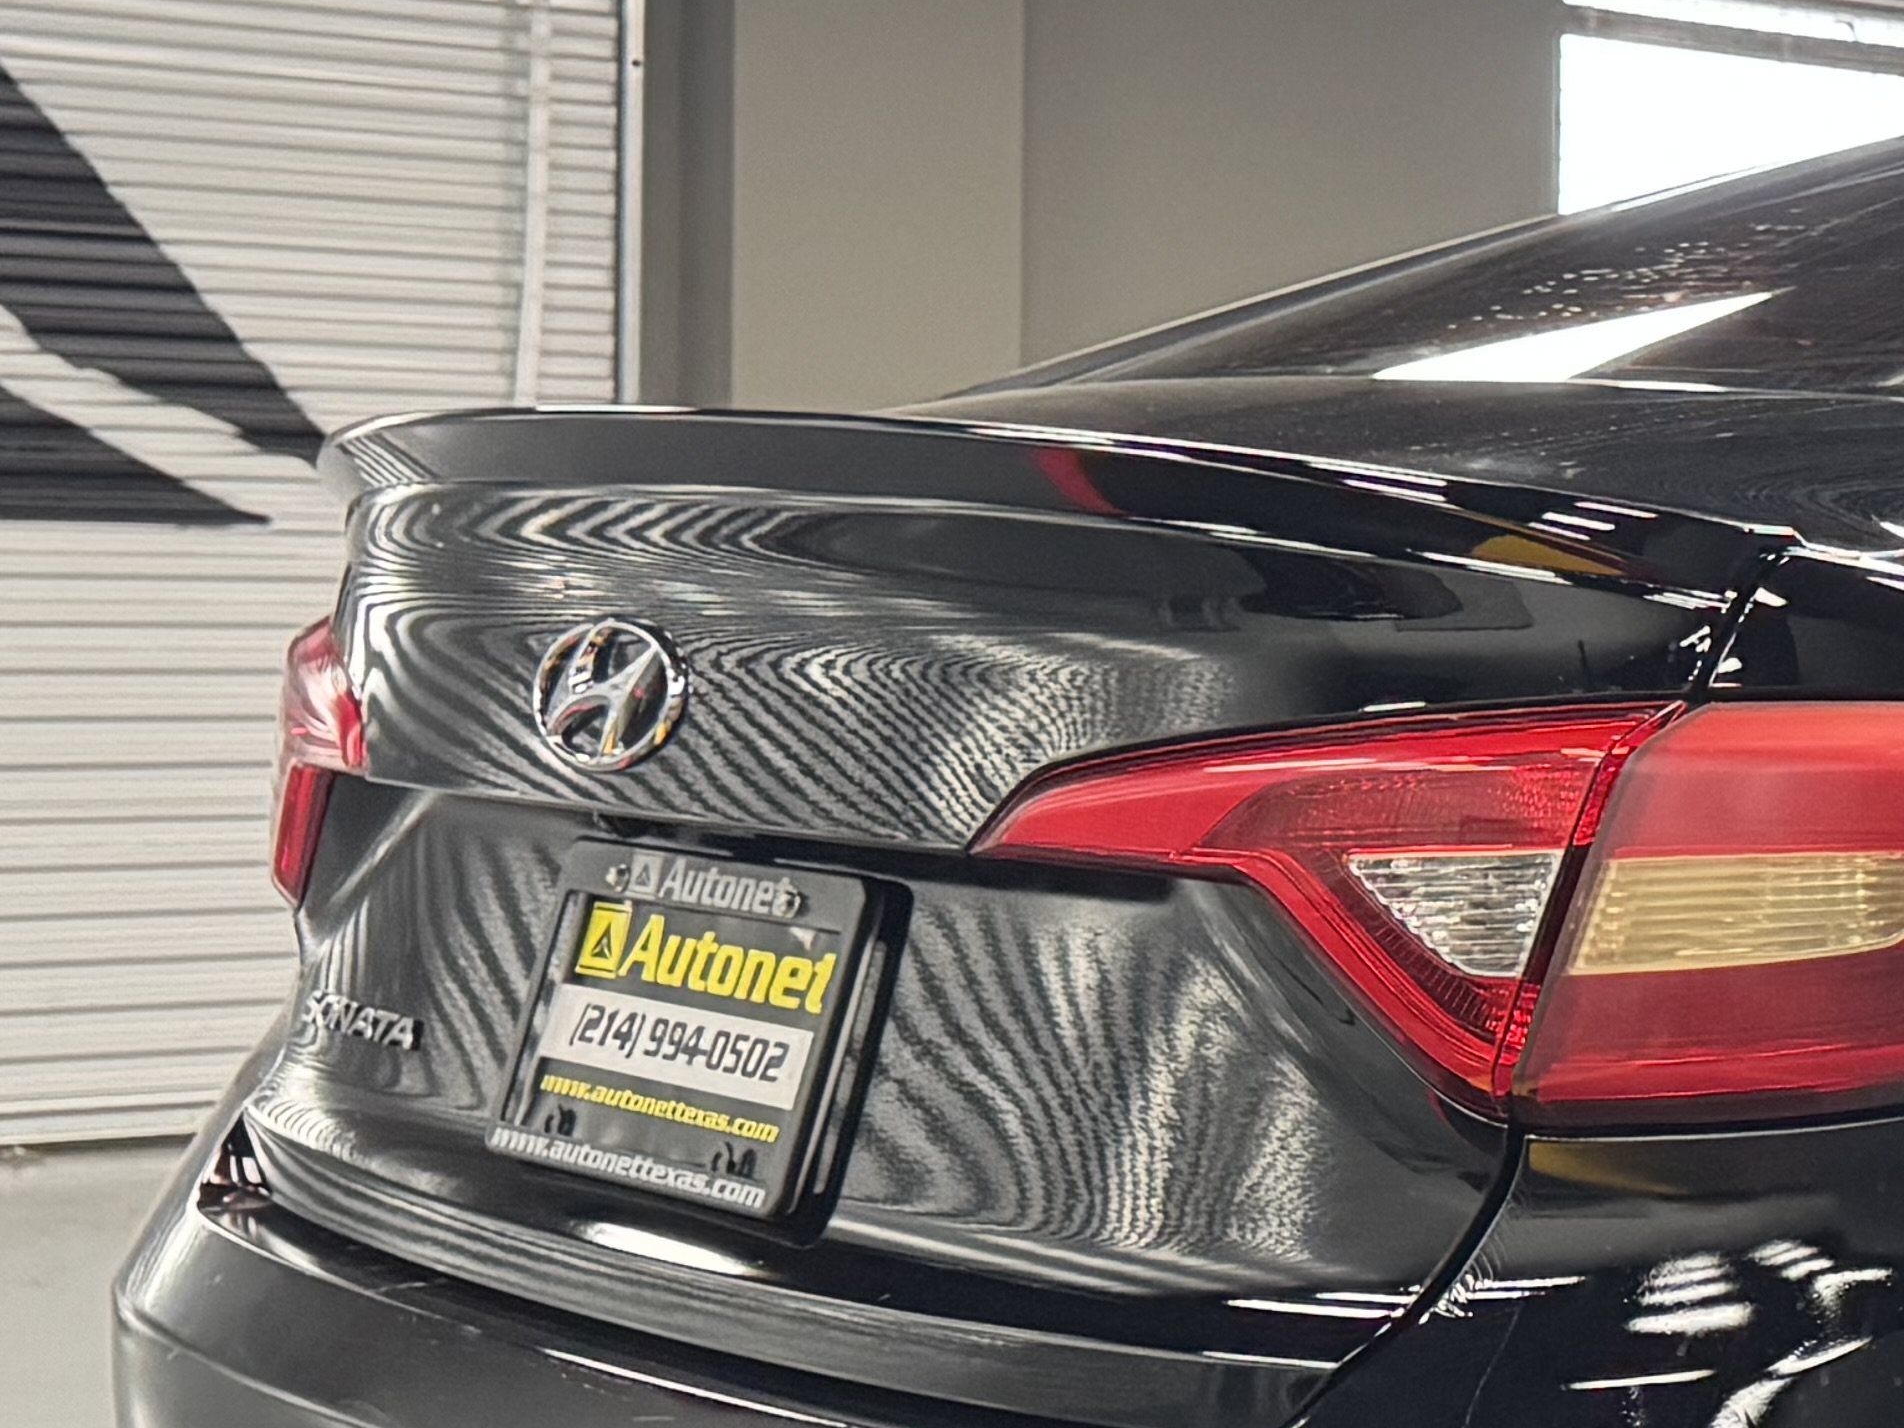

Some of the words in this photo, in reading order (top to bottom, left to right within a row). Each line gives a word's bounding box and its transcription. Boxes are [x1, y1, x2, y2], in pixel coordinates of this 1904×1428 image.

[618, 913, 837, 1015] Autonet
[569, 1002, 647, 1060] (214)
[644, 1018, 790, 1083] 994-0502
[540, 1074, 780, 1143] www.autonettexas.com
[490, 1126, 767, 1210] www.autonettexas.com
